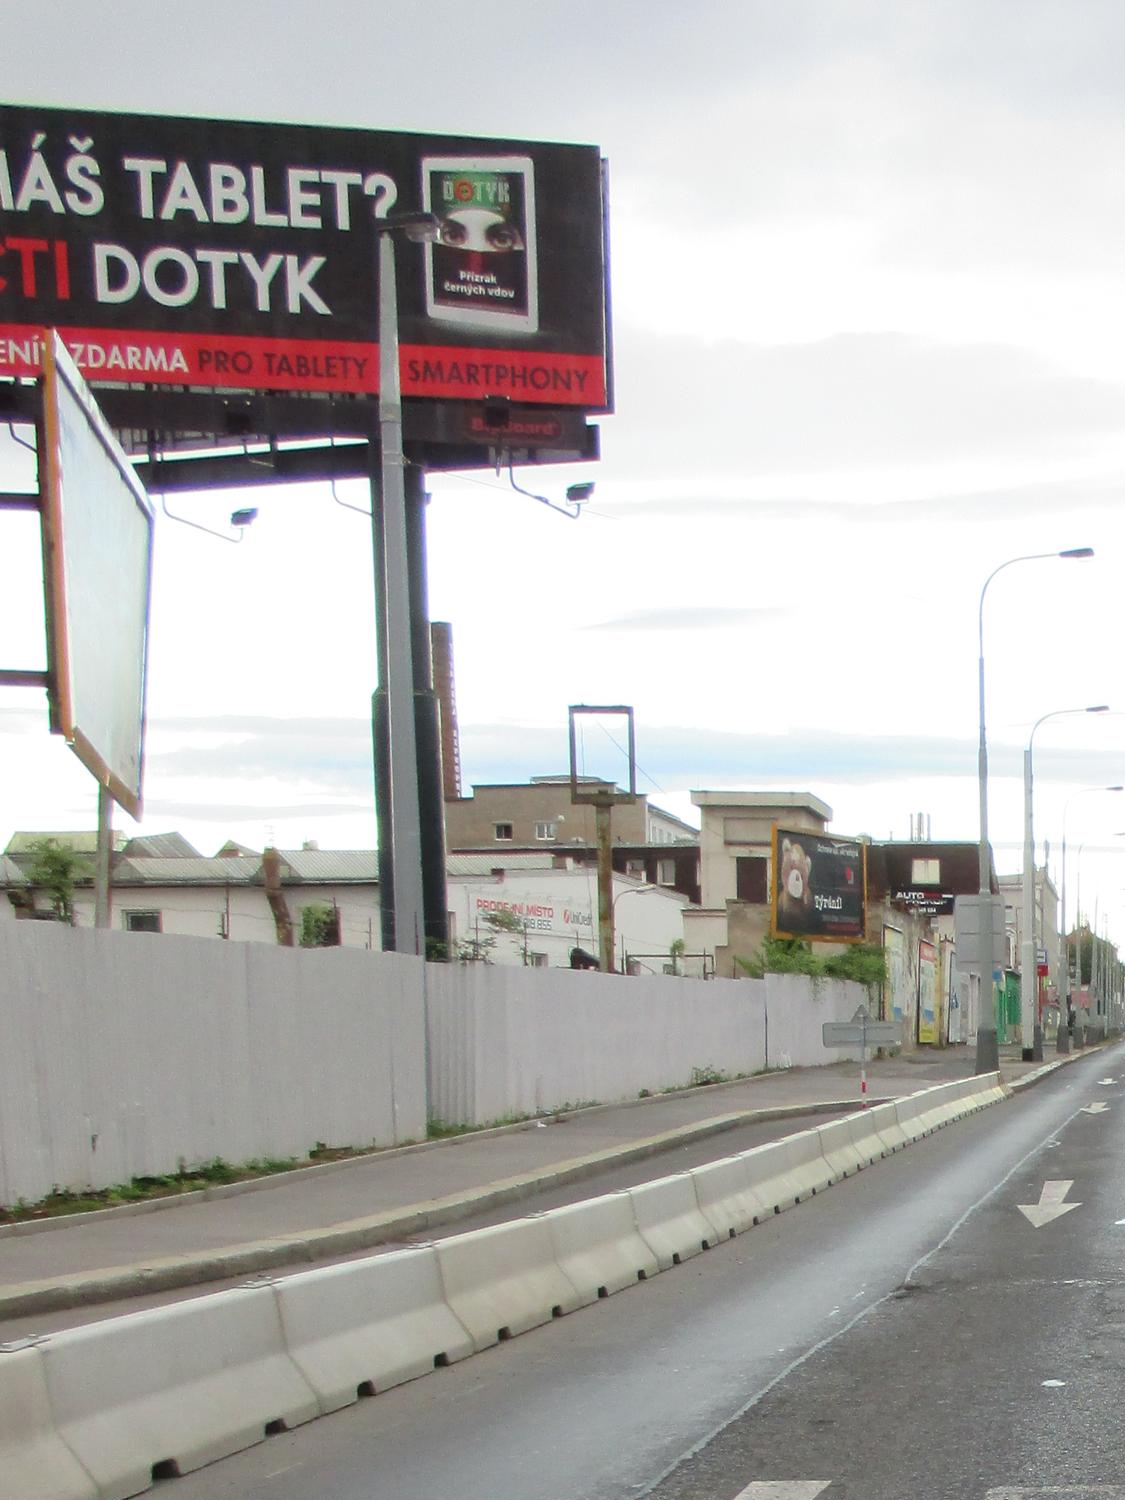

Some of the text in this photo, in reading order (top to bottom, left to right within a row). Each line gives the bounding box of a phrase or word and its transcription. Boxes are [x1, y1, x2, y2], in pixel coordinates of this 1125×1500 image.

[0, 132, 398, 231] ÁŠ TABLET?
[443, 179, 511, 203] DOTYK
[0, 237, 332, 316] TI DOTYK
[444, 280, 516, 299] černých vdov
[68, 342, 189, 374] ZDARMA
[197, 348, 255, 376] PRO
[263, 351, 369, 380] TABLETY
[407, 359, 589, 393] SMARTPHONY
[895, 891, 925, 900] AUTO
